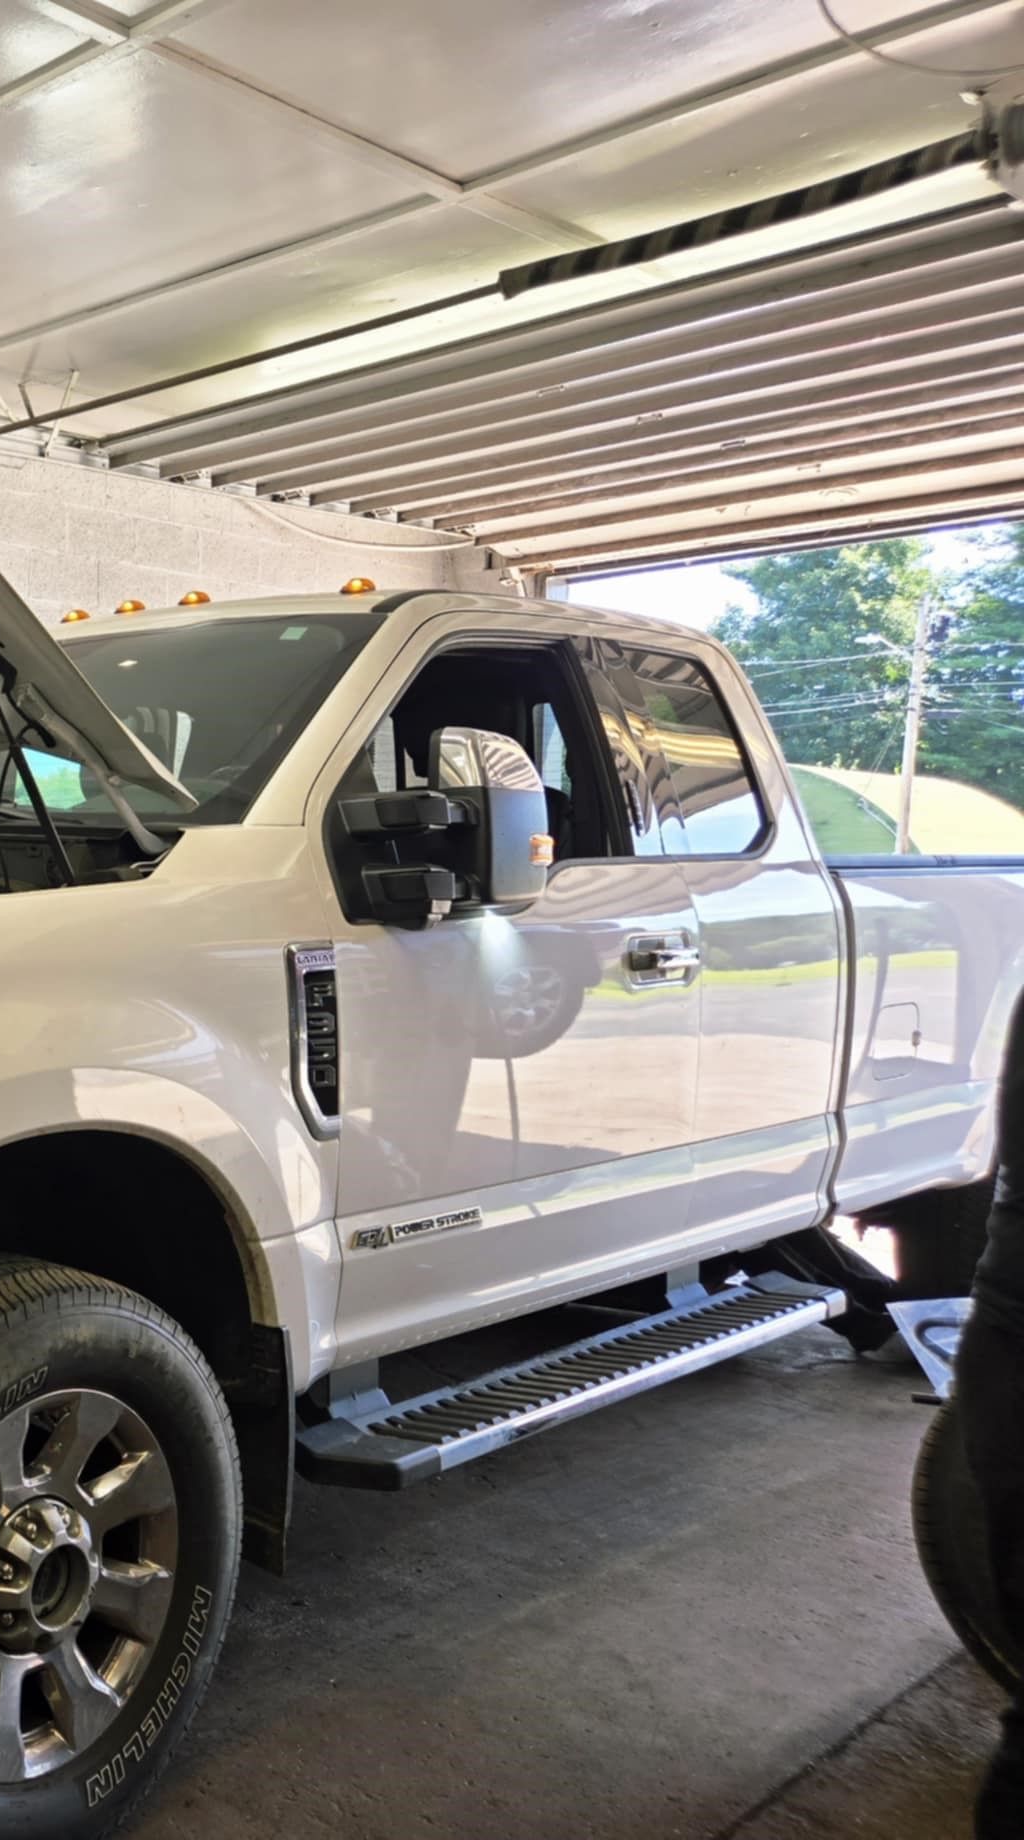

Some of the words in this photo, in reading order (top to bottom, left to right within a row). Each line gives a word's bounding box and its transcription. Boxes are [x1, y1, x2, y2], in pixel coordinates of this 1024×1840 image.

[394, 1218, 434, 1237] POWER
[436, 1208, 481, 1228] STROKE
[85, 1584, 214, 1808] MICHELIN
